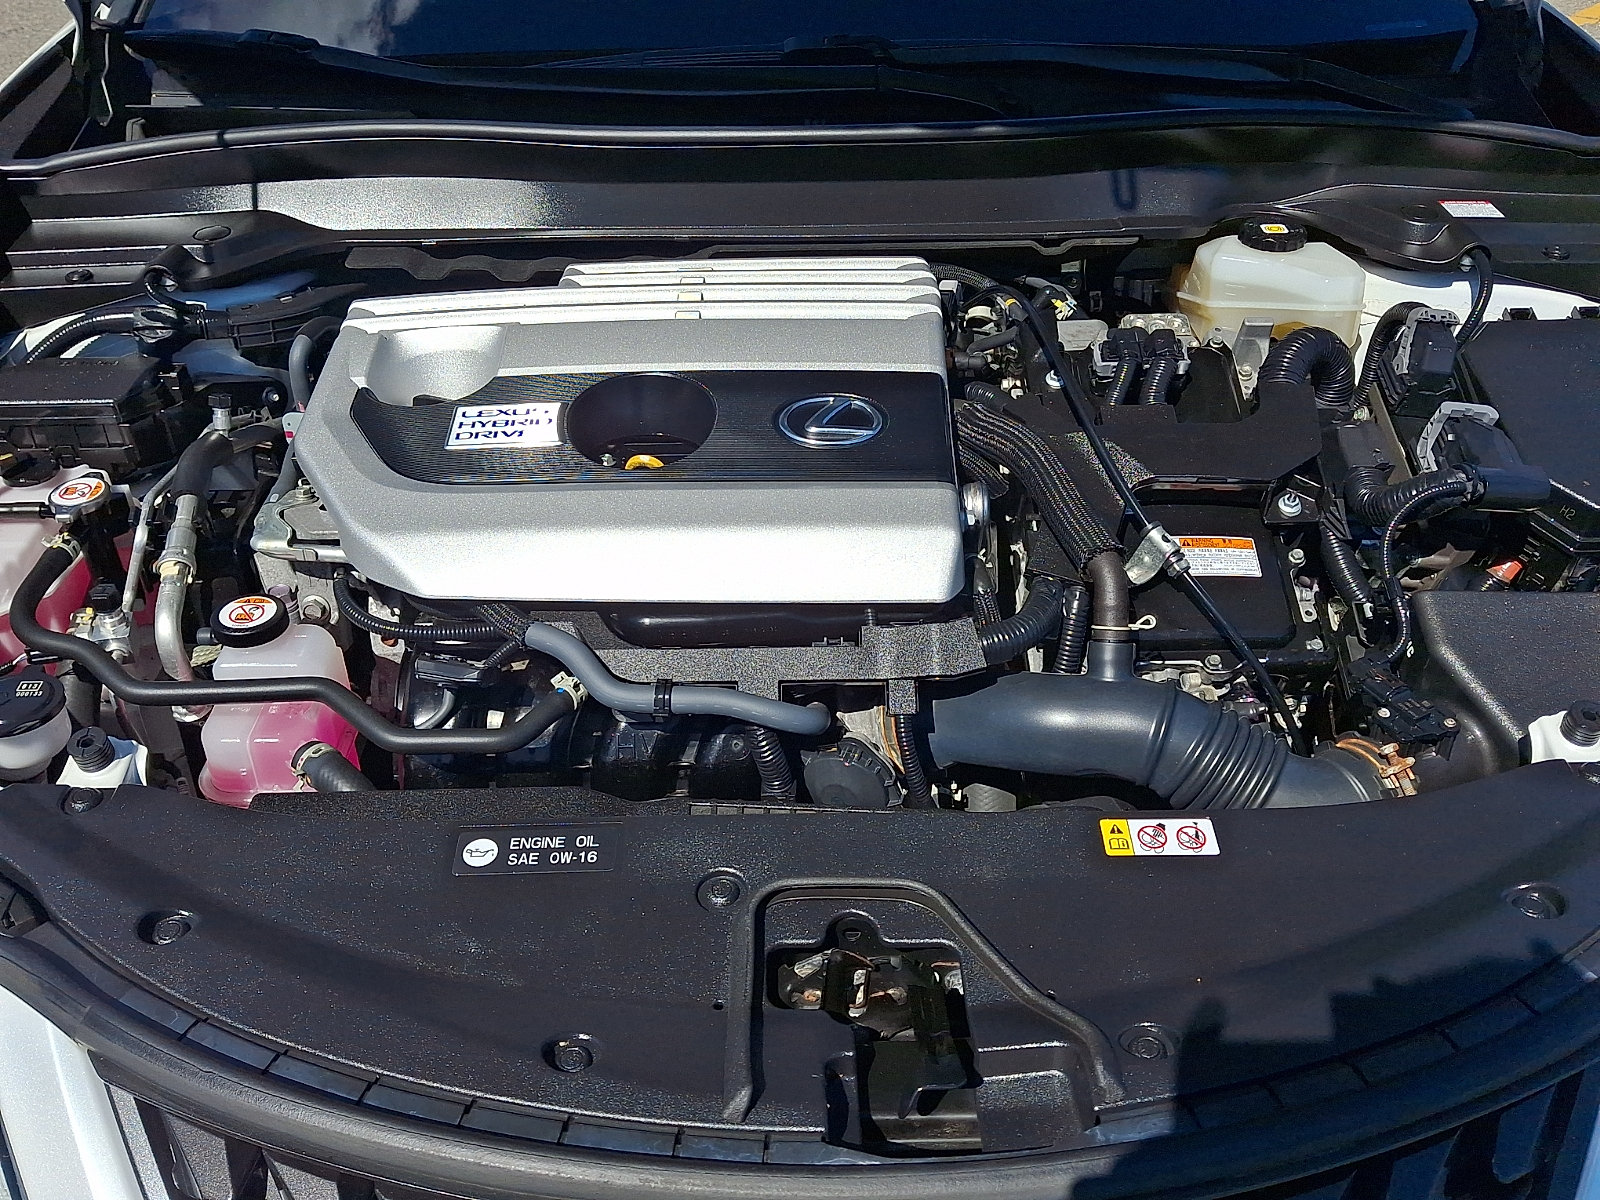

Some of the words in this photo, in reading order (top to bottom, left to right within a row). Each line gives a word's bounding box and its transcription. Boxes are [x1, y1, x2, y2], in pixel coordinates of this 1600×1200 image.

[1559, 504, 1576, 521] H2
[509, 837, 566, 849] ENGINE
[576, 836, 600, 848] OIL
[507, 853, 539, 866] SAE
[550, 851, 598, 864] 0W-16
